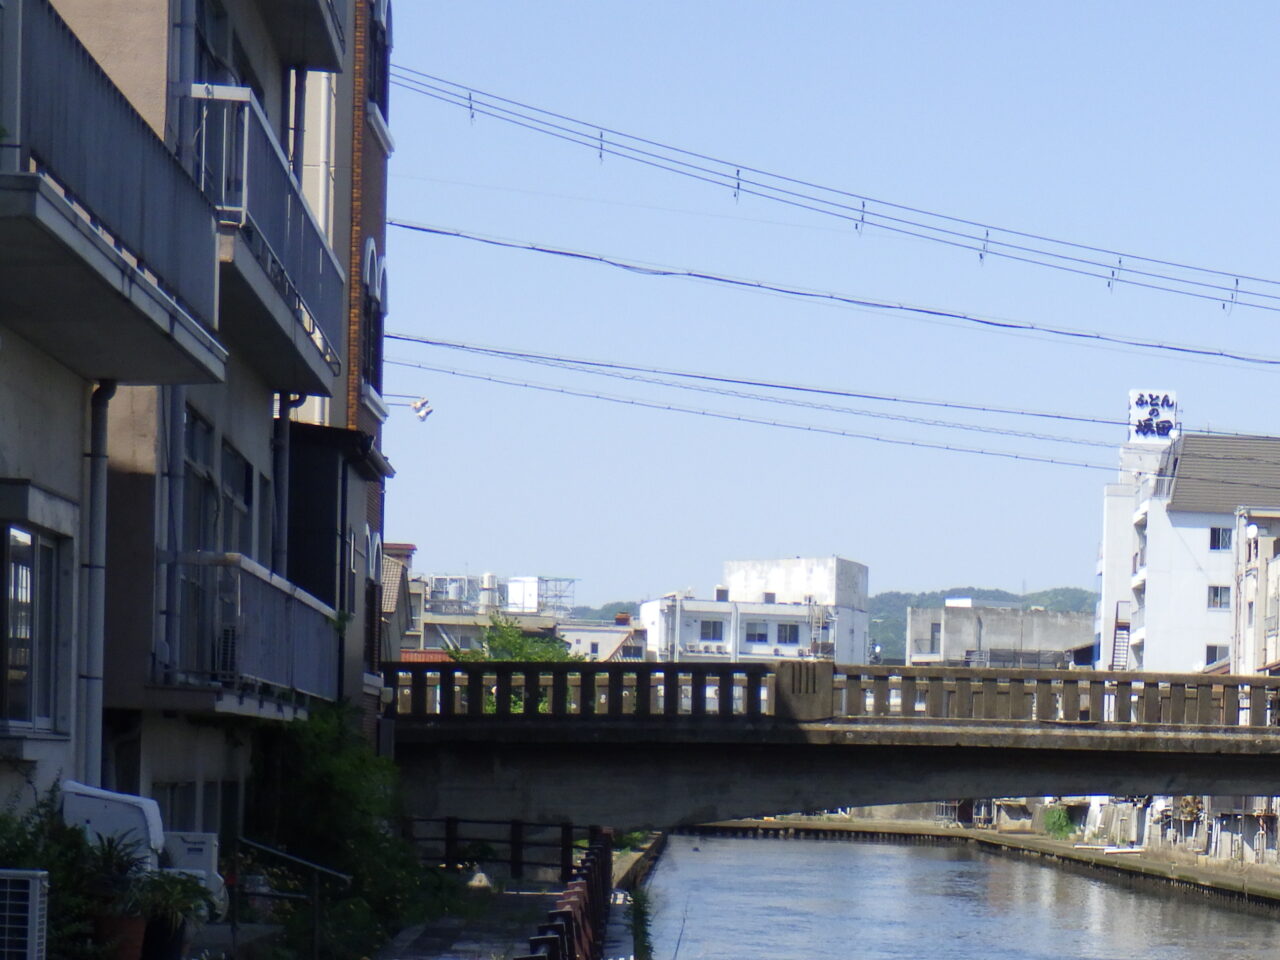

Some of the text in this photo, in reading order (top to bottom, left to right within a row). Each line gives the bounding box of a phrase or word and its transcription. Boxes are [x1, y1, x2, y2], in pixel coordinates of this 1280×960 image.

[1135, 393, 1175, 408] ふとん
[1149, 407, 1160, 418] の
